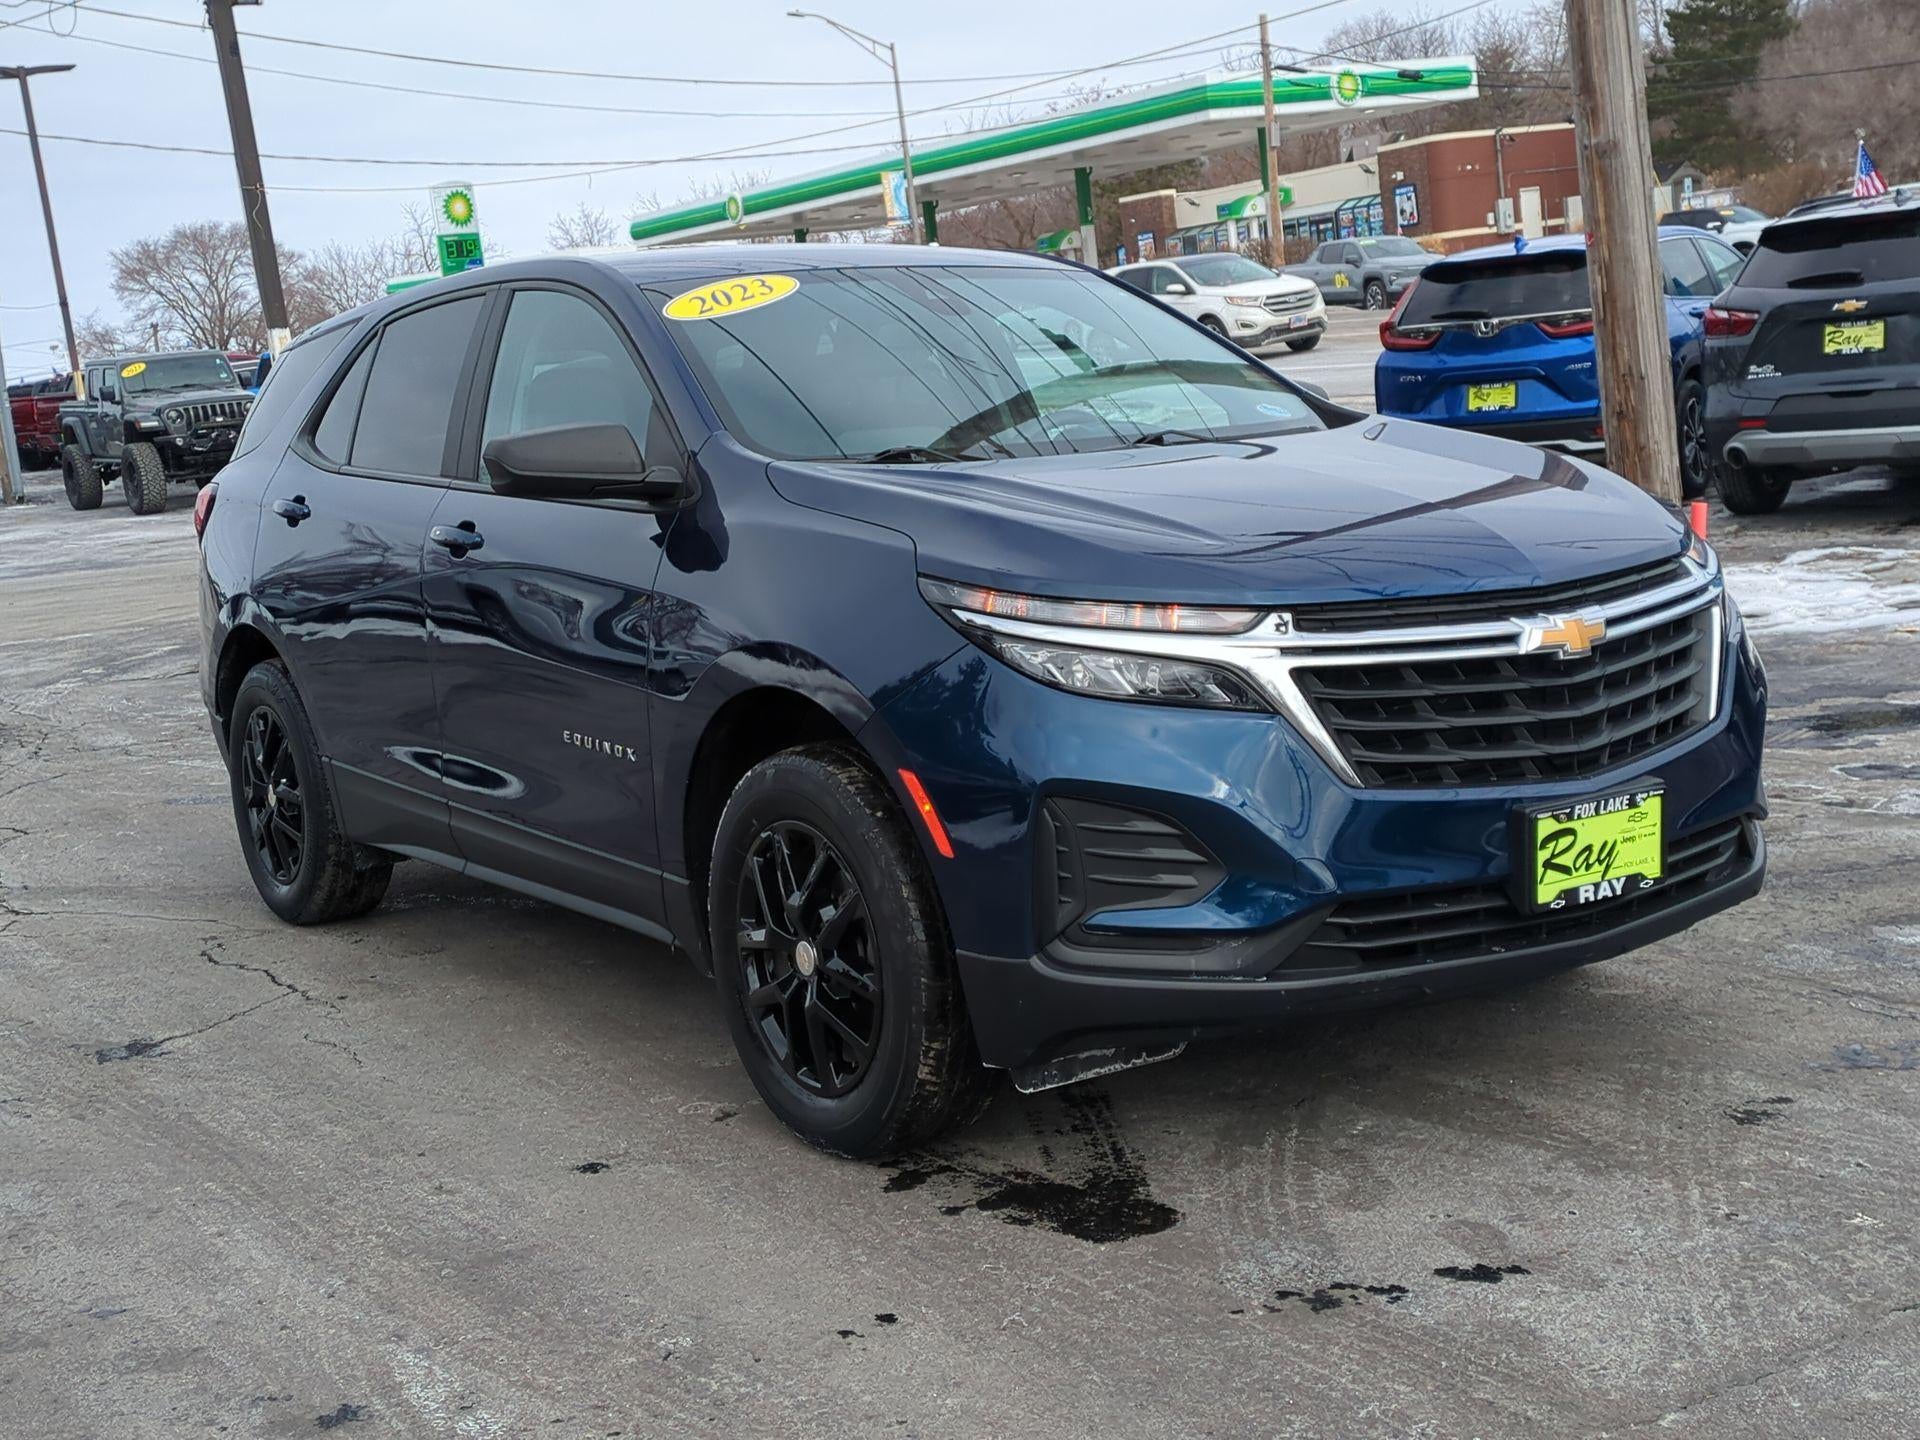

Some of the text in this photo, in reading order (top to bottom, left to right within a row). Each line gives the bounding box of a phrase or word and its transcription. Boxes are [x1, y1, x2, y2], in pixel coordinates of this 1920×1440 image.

[688, 279, 774, 315] 2023
[1826, 329, 1863, 349] Ray
[563, 730, 637, 761] EQUINOX
[1573, 801, 1597, 820] FOX
[1600, 795, 1630, 815] LAKE
[1620, 834, 1637, 845] Jeep
[1539, 828, 1619, 885] Ray
[1579, 877, 1627, 904] RAY
